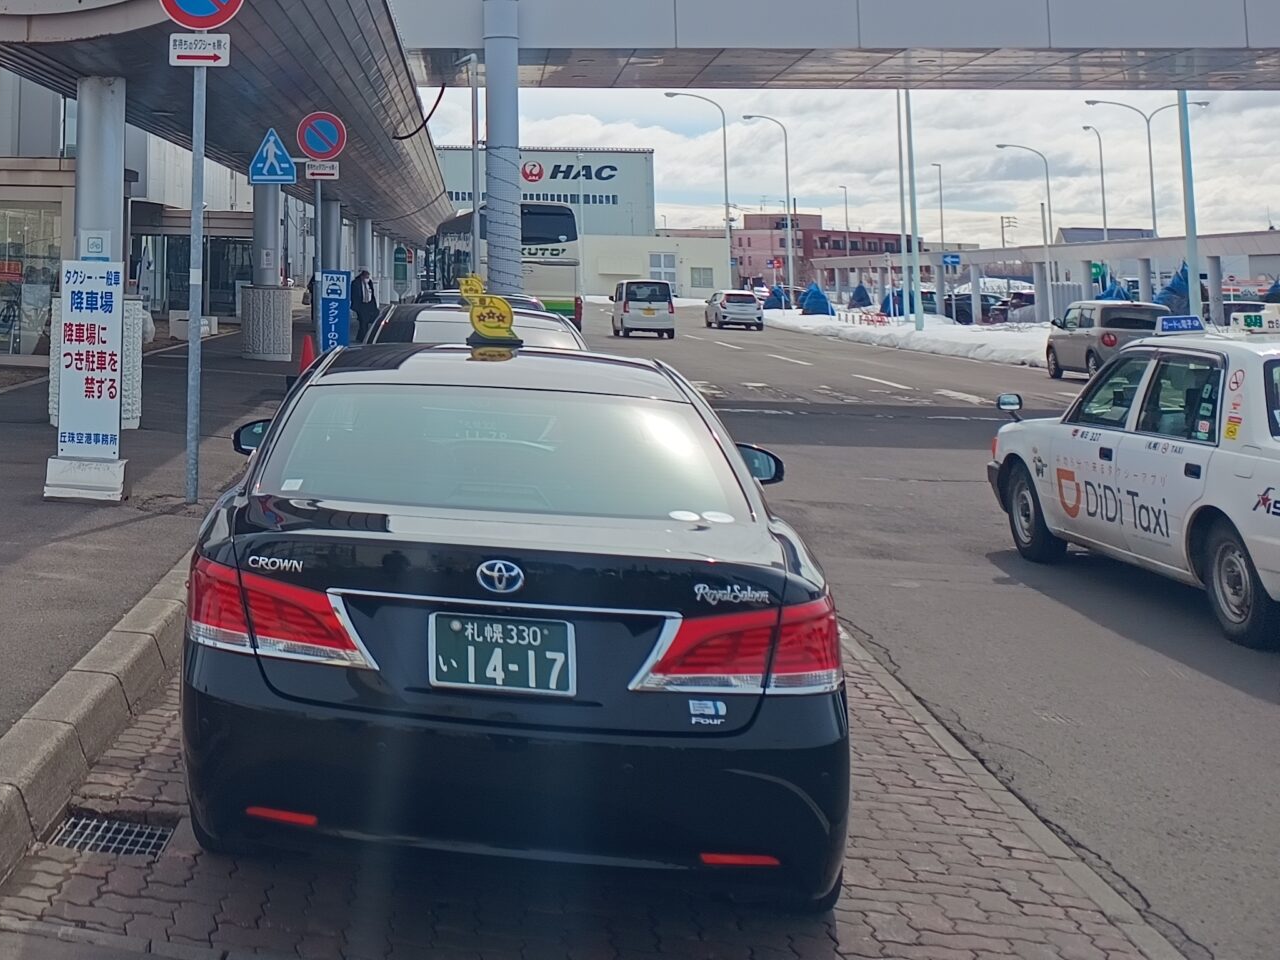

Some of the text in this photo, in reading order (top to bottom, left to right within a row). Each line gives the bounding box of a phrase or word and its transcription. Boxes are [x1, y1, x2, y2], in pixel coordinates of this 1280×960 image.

[549, 164, 618, 181] HAC
[65, 270, 120, 286] タクシー・一般車
[70, 290, 113, 313] 降車場
[63, 322, 107, 345] 降車場に
[63, 350, 118, 372] つき駐車を
[84, 376, 117, 399] 禁ずる
[60, 431, 118, 445] 丘珠空港事務所
[1084, 480, 1170, 538] DiDi Taxi
[248, 555, 303, 573] CROWN
[438, 645, 565, 689] い 14-17
[691, 716, 725, 725] Four
